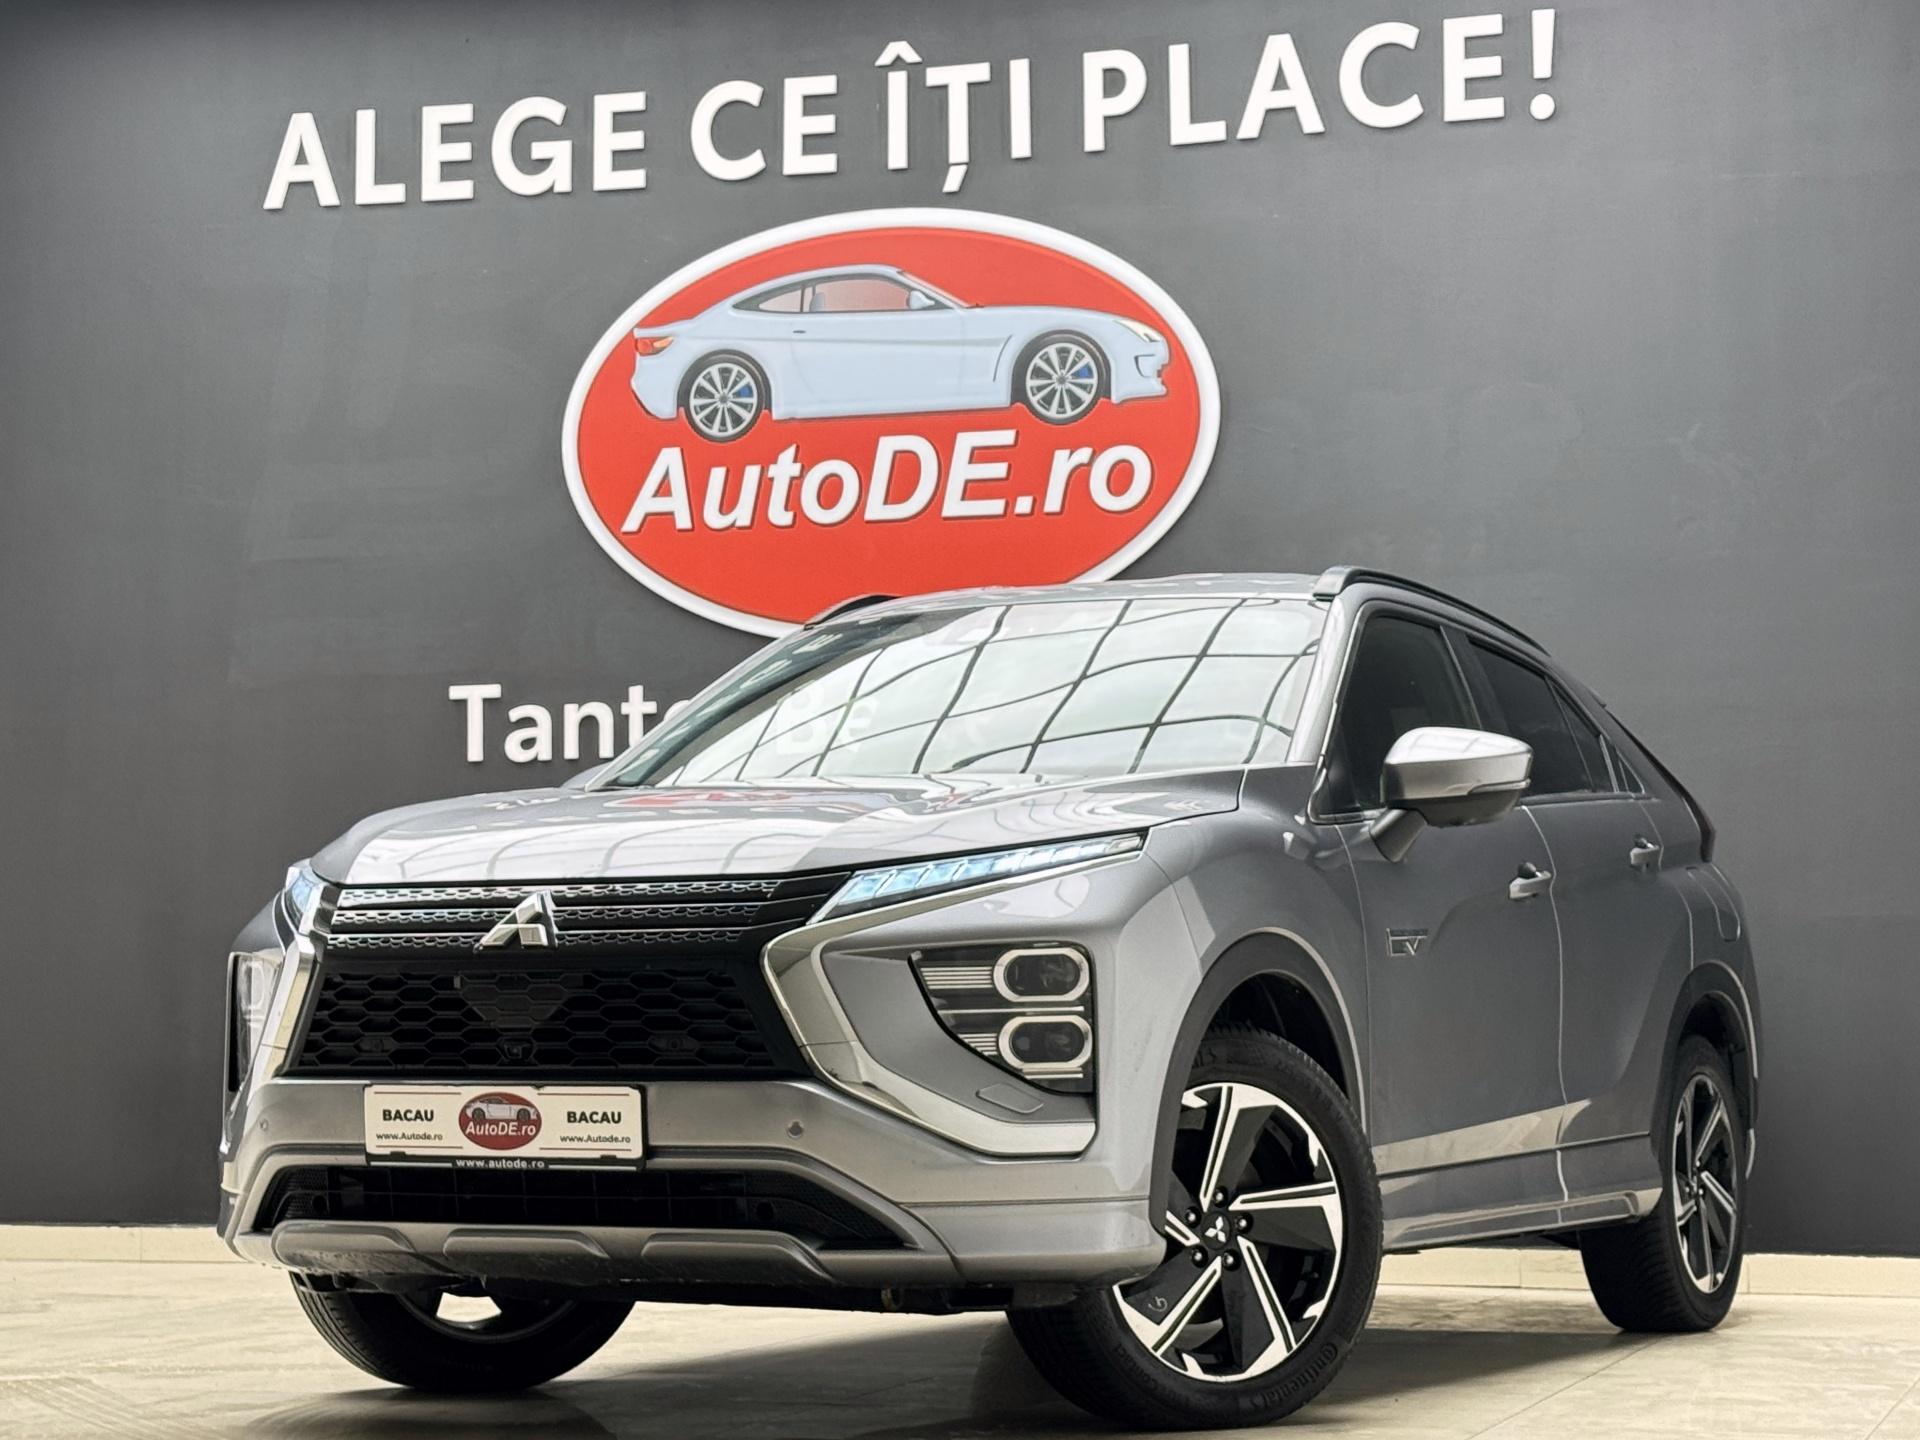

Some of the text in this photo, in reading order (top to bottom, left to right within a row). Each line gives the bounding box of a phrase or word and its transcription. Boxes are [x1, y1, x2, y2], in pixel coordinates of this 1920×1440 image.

[263, 91, 647, 209] ALEGE
[690, 75, 838, 181] CE
[1083, 8, 1556, 153] PLACE!
[621, 429, 1153, 534] AutoDE.ro
[449, 684, 690, 763] Tant
[382, 1109, 434, 1122] BACAU
[566, 1111, 622, 1124] BACAU
[464, 1121, 538, 1137] AutoDE.ro
[375, 1132, 444, 1142] www.Autode.ro
[559, 1133, 632, 1145] www.Autode.ro
[455, 1158, 546, 1170] www.autode.ro
